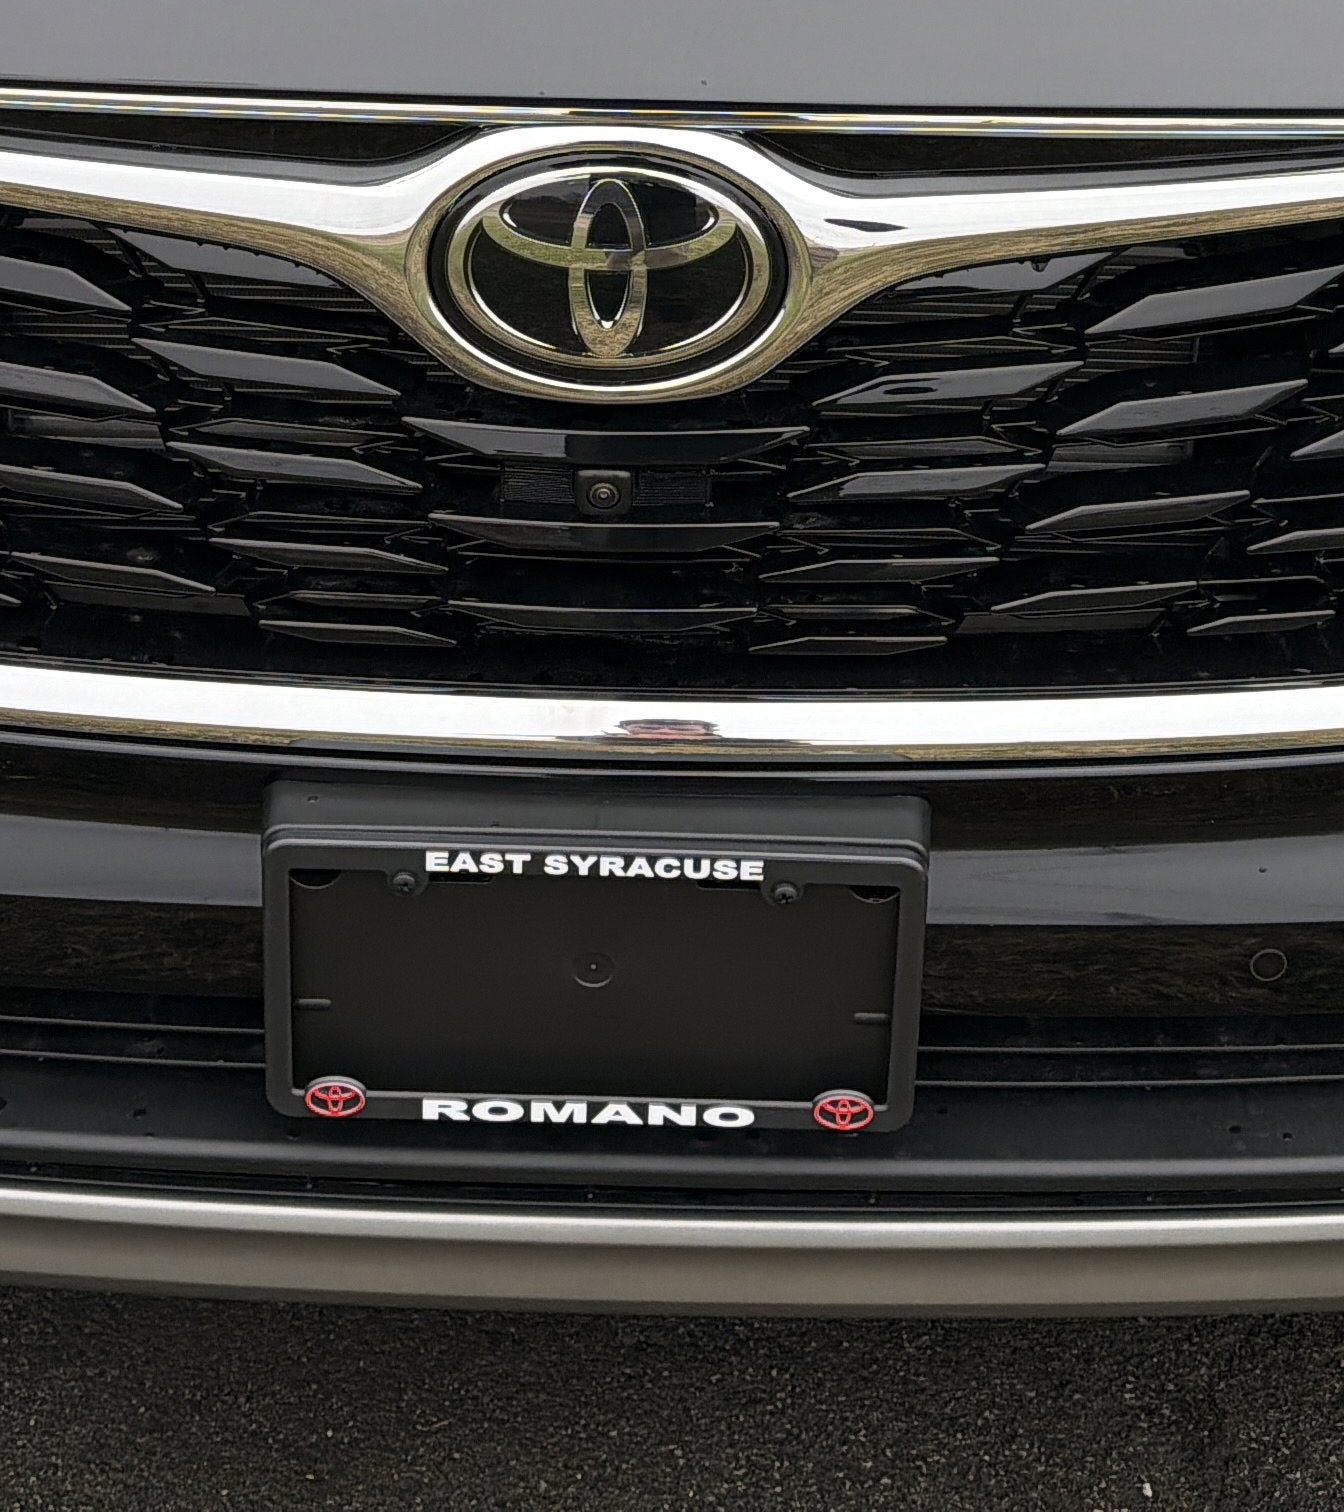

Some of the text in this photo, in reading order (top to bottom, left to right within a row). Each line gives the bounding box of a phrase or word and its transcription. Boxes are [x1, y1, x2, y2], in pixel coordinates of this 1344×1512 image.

[425, 850, 765, 881] EAST SYRACUSE
[422, 1098, 756, 1128] ROMANO
